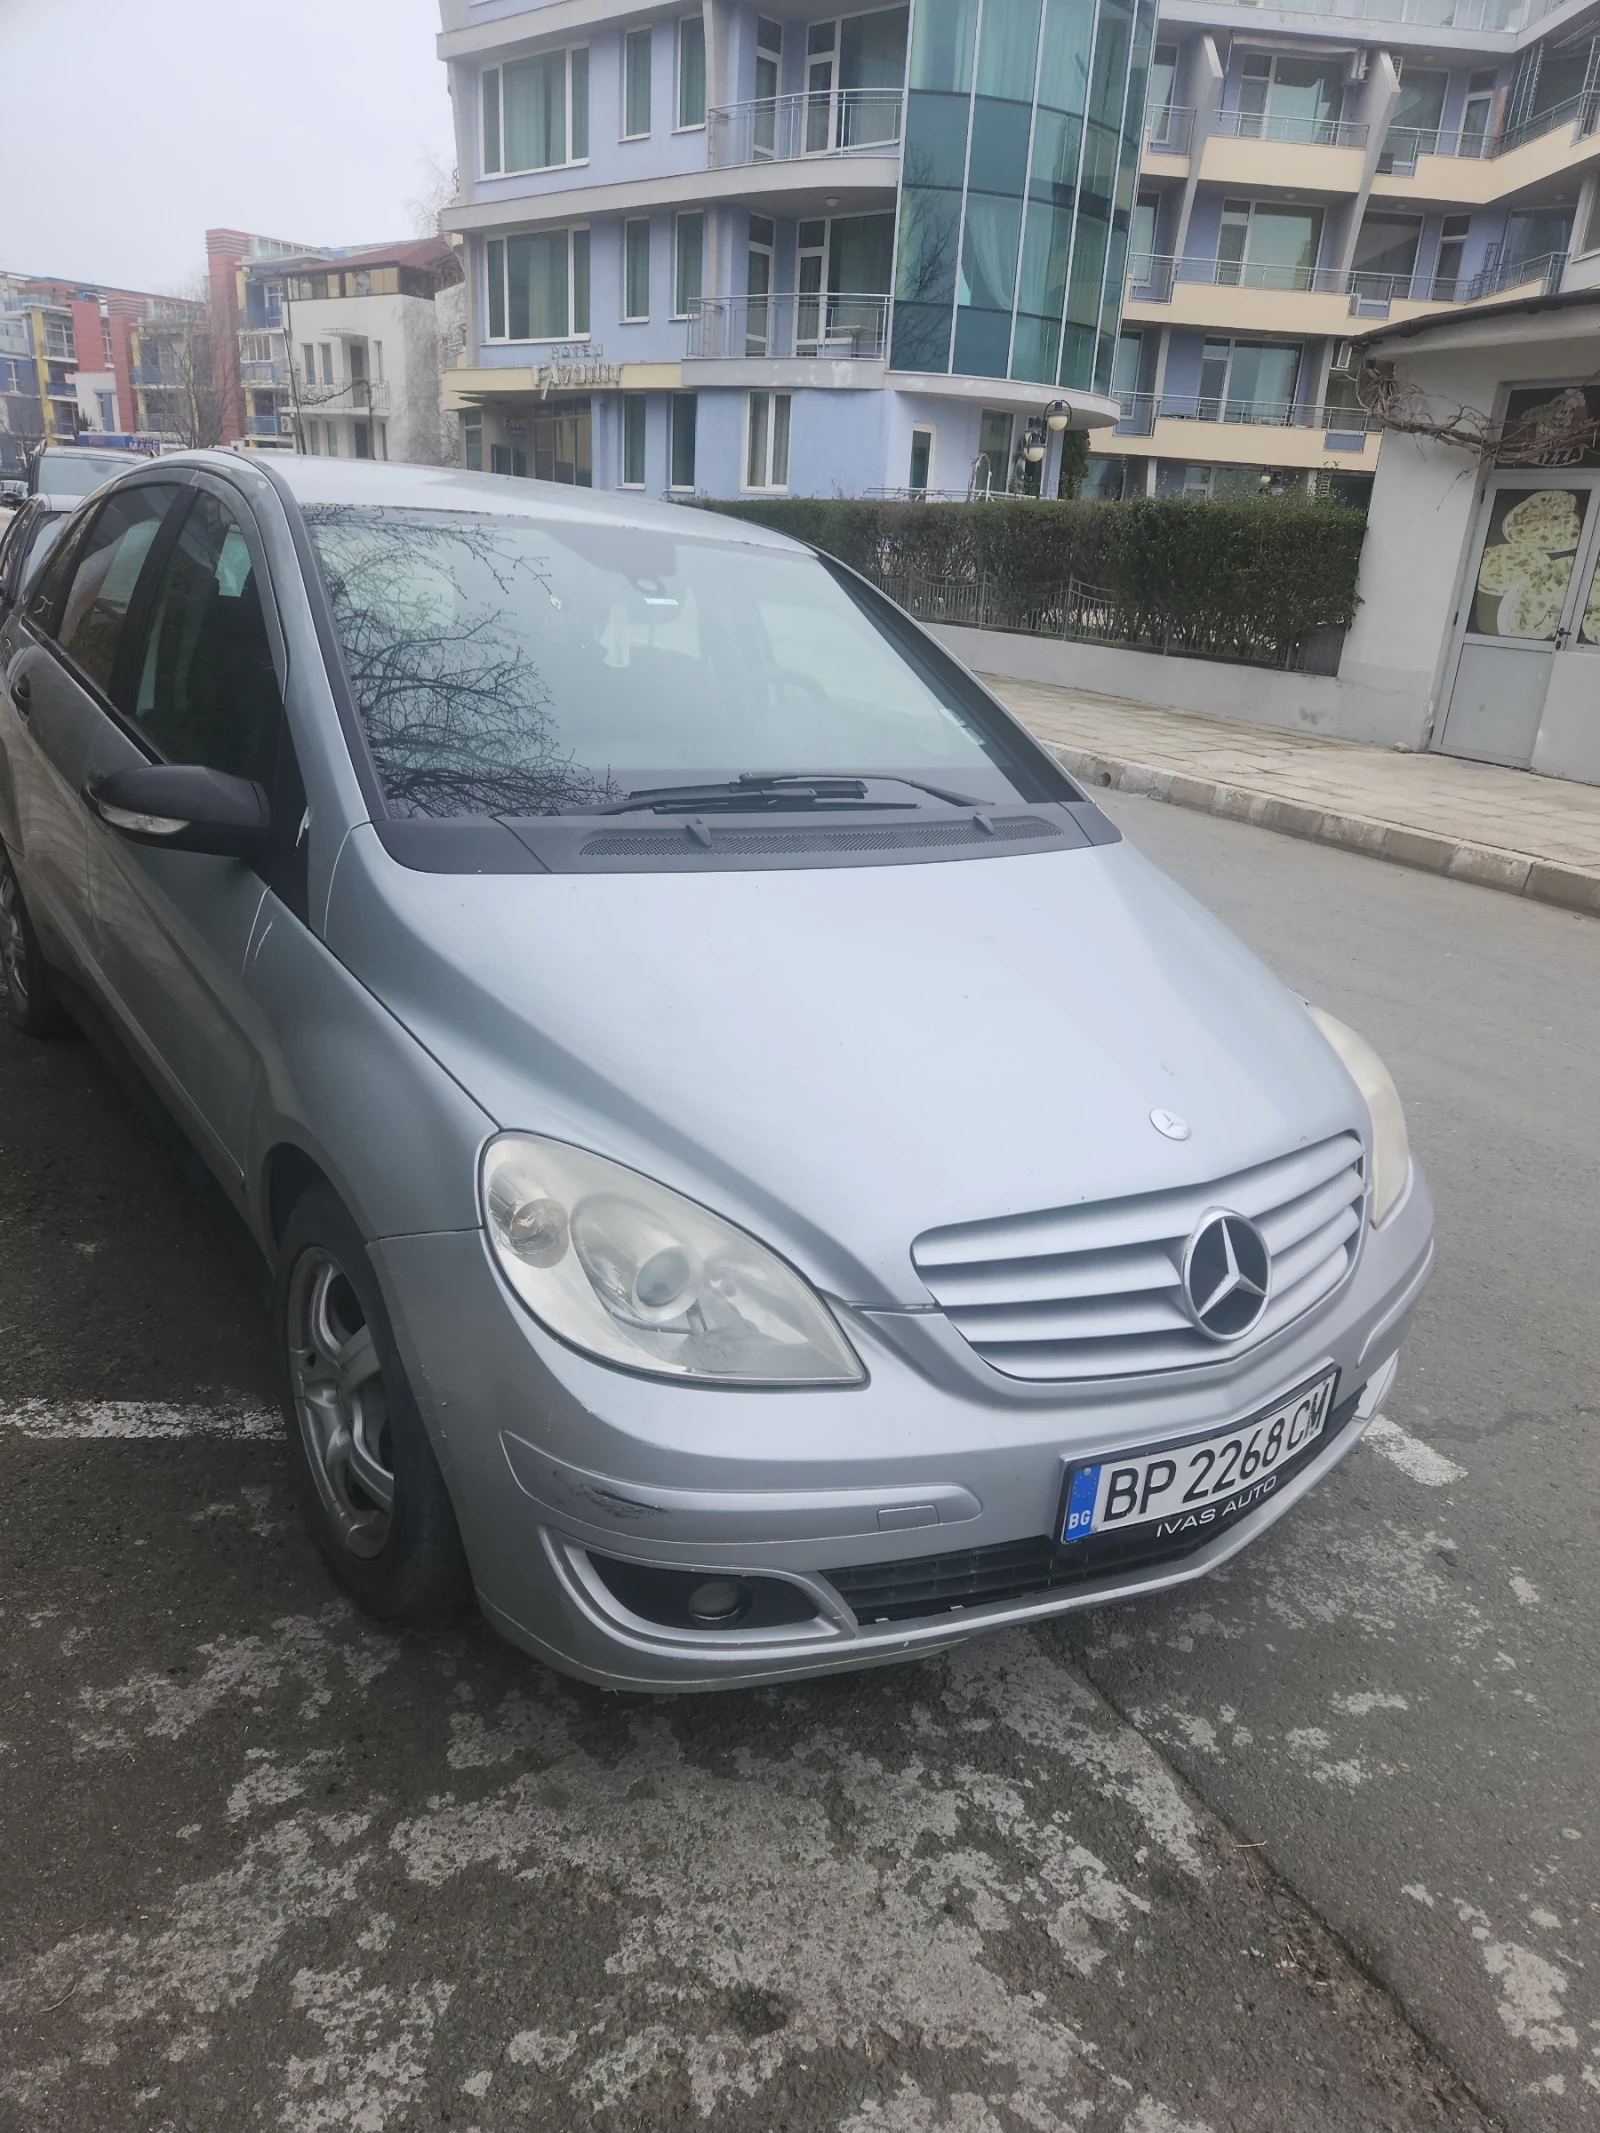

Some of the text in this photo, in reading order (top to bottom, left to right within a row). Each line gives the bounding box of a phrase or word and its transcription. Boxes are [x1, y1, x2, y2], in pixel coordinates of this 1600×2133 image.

[550, 344, 603, 360] HOTEL
[1532, 445, 1582, 466] IZZA
[1103, 1459, 1176, 1522] BP
[1182, 1417, 1285, 1503] 2268
[1156, 1475, 1276, 1537] IVAS AUTO
[1069, 1510, 1091, 1529] BG
